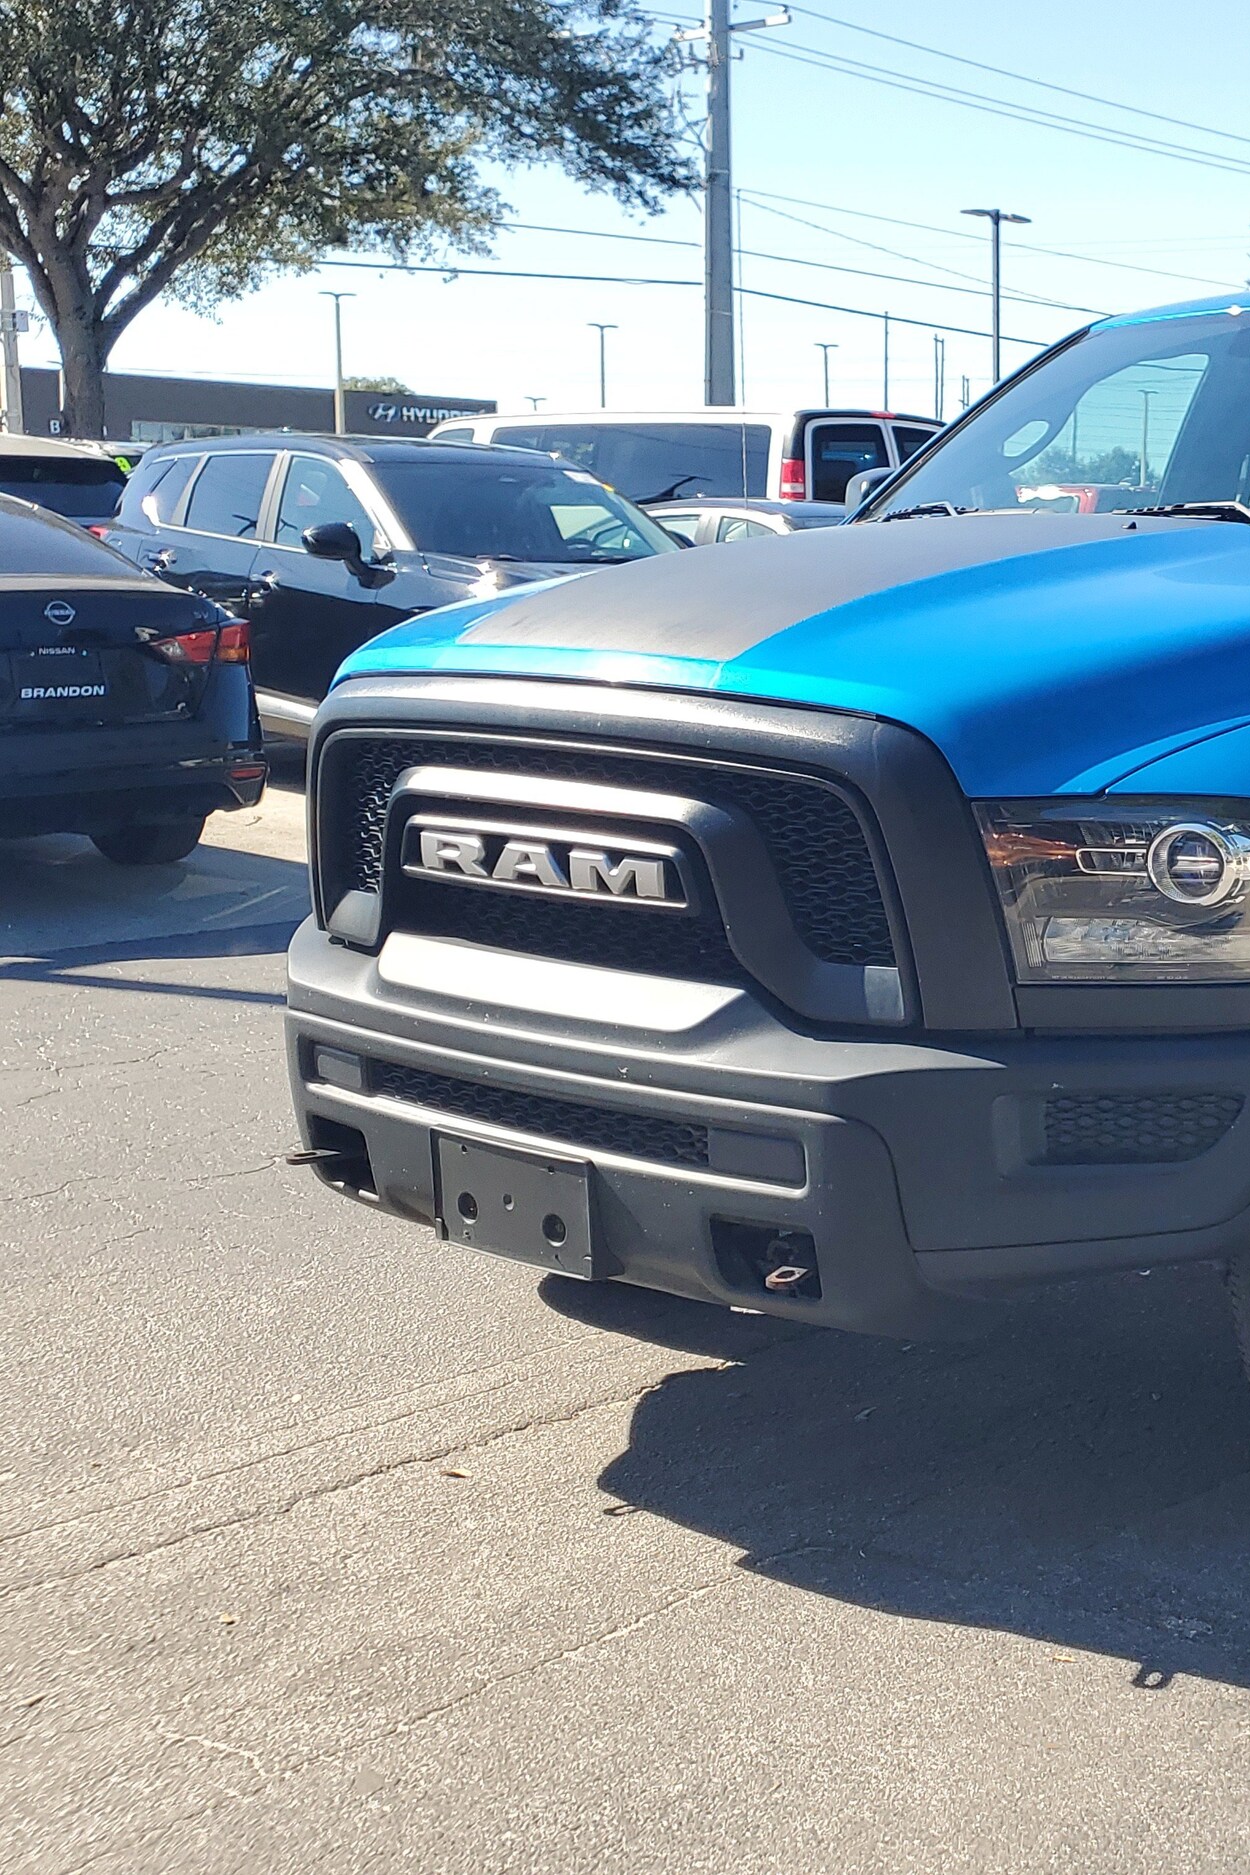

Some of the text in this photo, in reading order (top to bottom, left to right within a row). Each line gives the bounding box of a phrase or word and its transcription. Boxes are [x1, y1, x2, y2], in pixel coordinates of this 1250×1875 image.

[401, 406, 485, 424] HYUN
[38, 647, 76, 655] NISSAN
[20, 684, 105, 699] BRANDON
[420, 830, 666, 899] RAM
